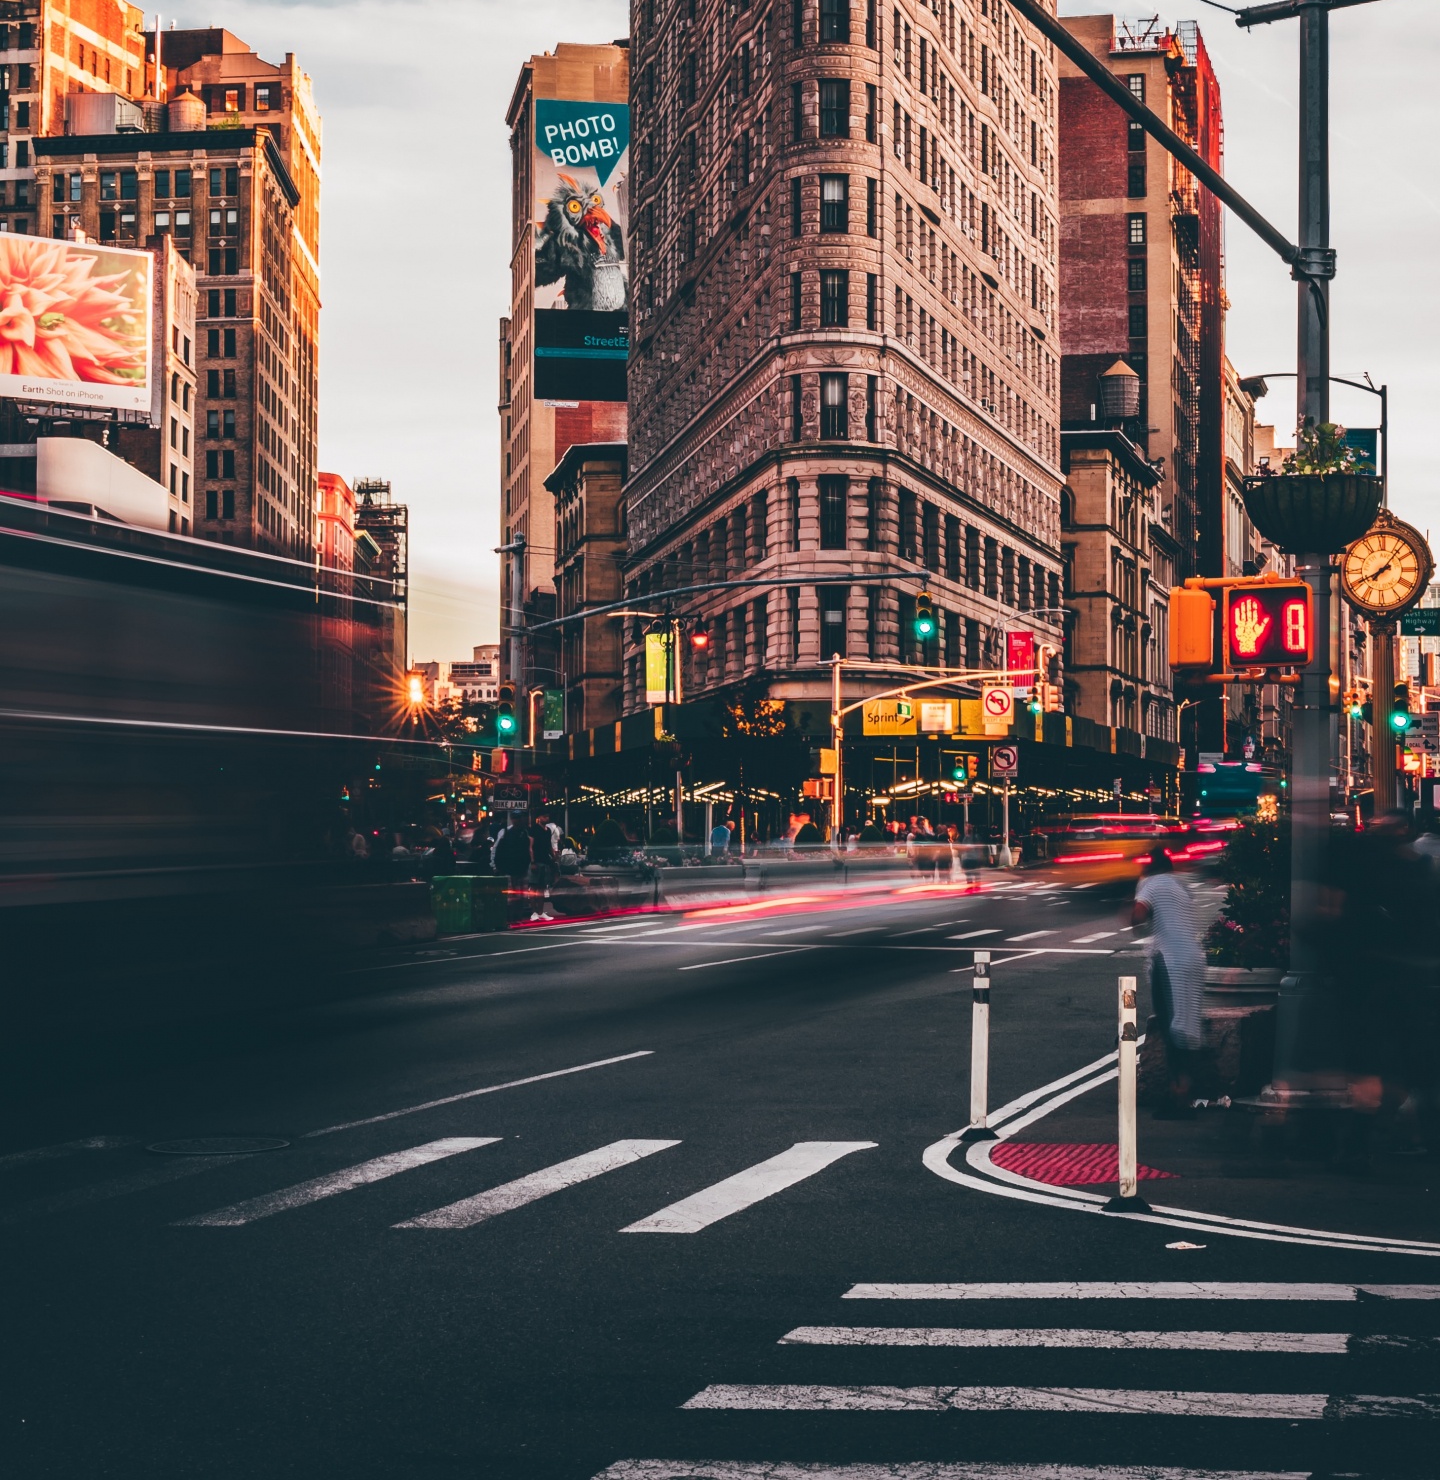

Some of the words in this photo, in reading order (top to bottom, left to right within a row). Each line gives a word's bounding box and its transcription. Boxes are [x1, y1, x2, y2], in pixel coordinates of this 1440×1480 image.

[545, 114, 615, 143] PHOTO
[551, 137, 620, 167] BOMB!
[22, 385, 44, 394] Earth
[46, 387, 64, 397] Shot
[65, 390, 76, 398] on
[77, 391, 104, 401] iPhone
[868, 713, 899, 725] Sprint
[510, 801, 527, 809] LANE
